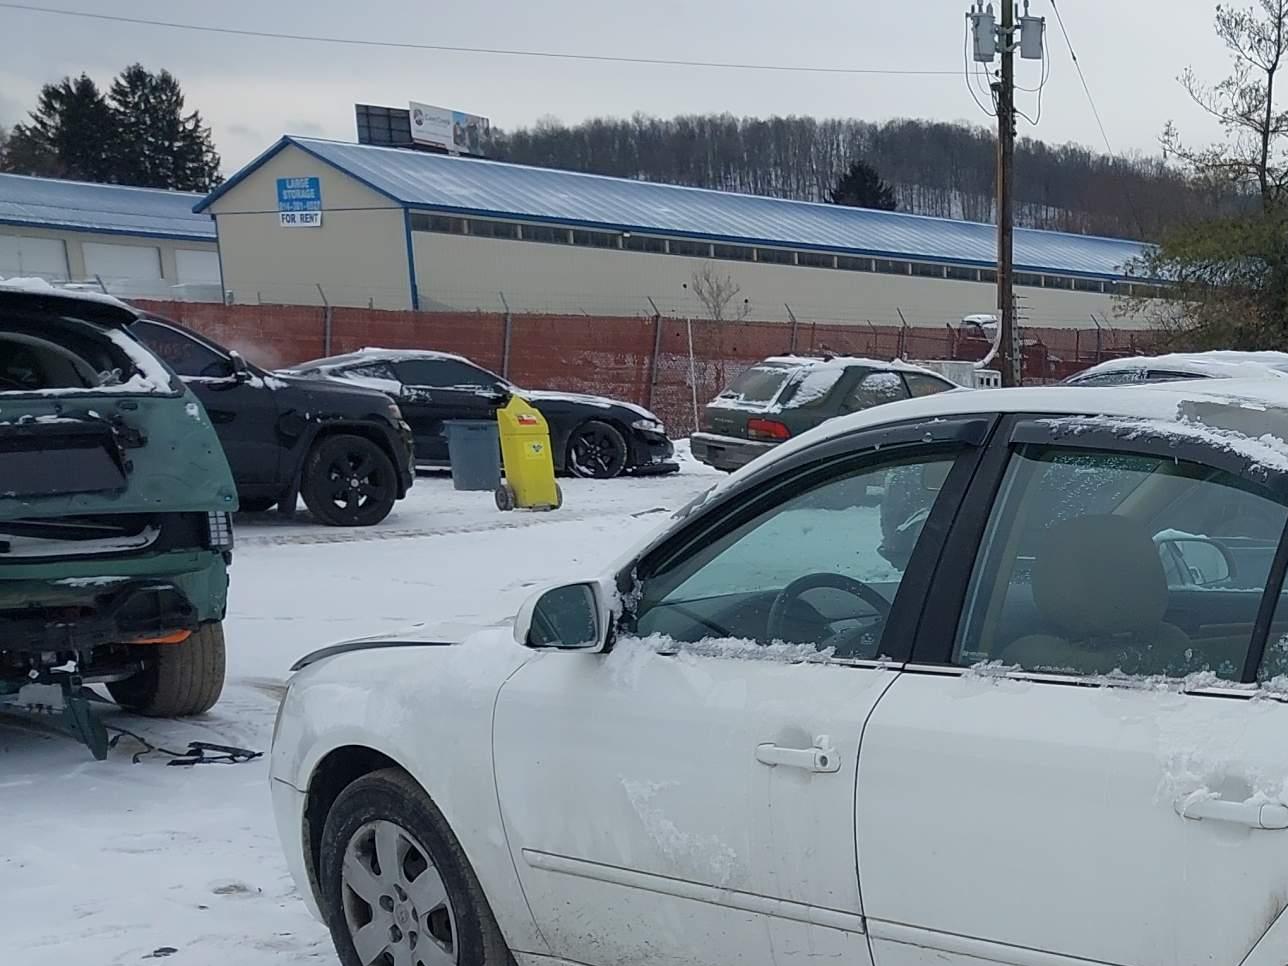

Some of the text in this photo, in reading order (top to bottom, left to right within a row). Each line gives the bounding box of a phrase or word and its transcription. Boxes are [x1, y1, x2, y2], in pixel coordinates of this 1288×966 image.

[283, 189, 315, 200] STORAGE
[281, 213, 319, 224] FOR RENT
